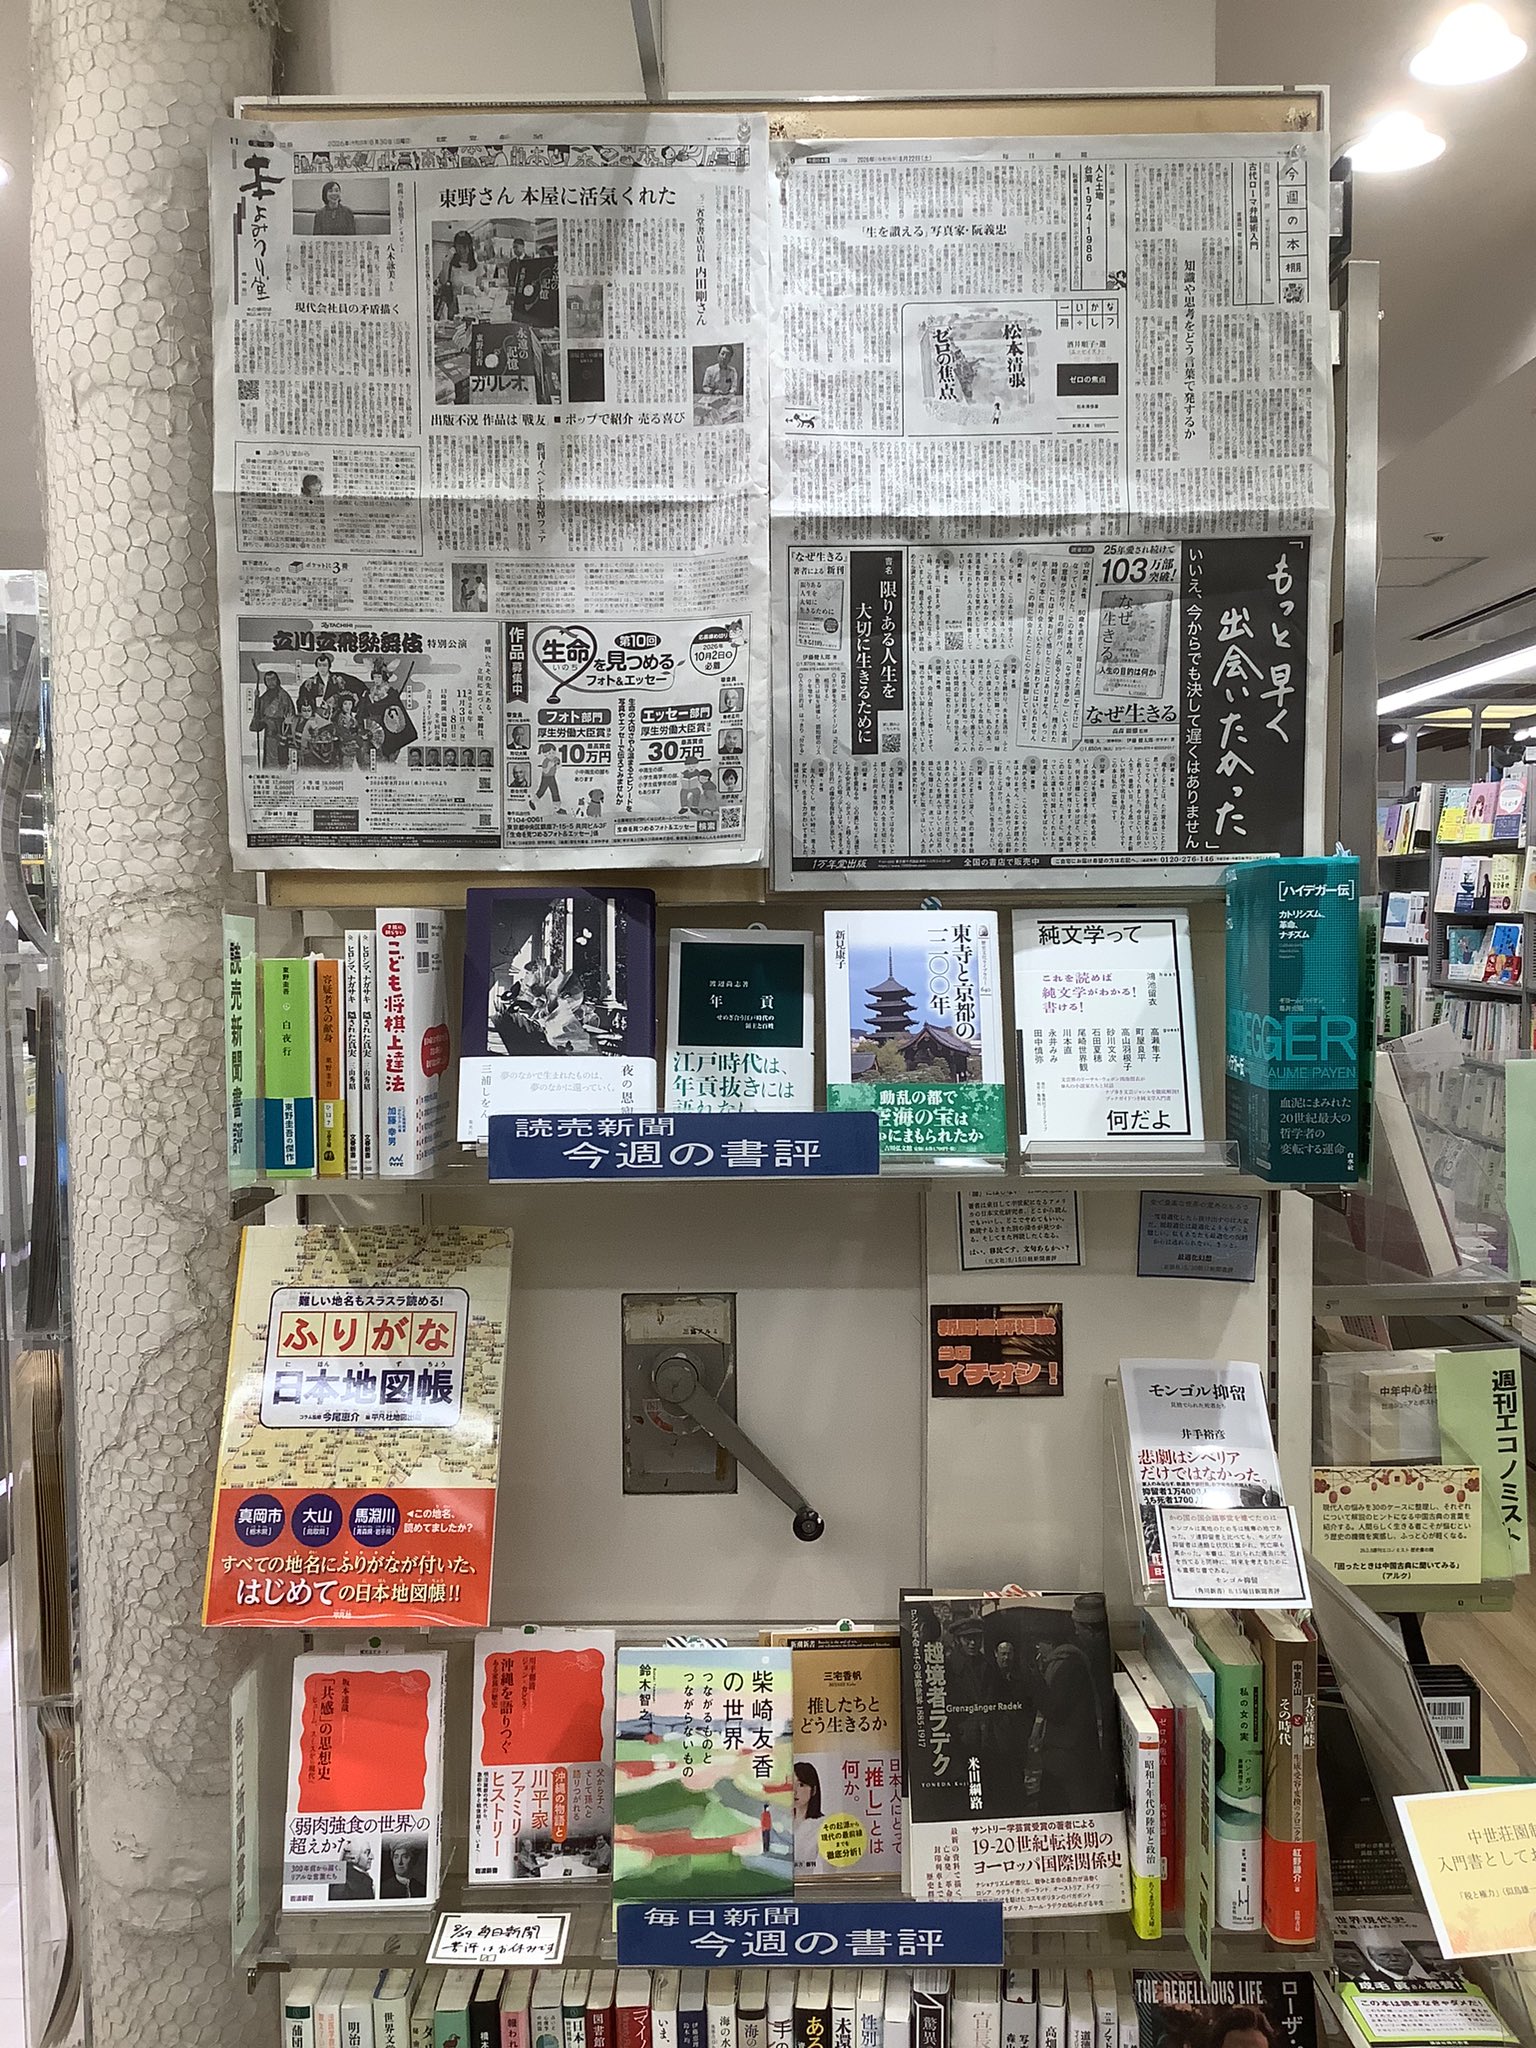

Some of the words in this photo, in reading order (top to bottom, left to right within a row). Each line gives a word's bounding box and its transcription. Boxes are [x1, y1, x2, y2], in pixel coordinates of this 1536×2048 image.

[1095, 164, 1103, 200] 人と土地
[439, 187, 514, 208] 東野さん
[521, 186, 676, 206] 本屋に活気くれた
[1285, 167, 1302, 273] 今週の本棚
[295, 303, 399, 314] 現代会社員の矛盾描く
[1003, 324, 1026, 388] 松本清張
[1184, 259, 1196, 440] 知識や思考をどう言葉で発するか
[932, 326, 957, 400] ゼロの焦点
[1069, 376, 1106, 384] ゼロの焦点
[431, 414, 478, 426] 出版不況
[638, 413, 685, 424] 売る喜び
[1102, 558, 1147, 583] 103
[273, 631, 423, 653] 立川立飛歌舞伎
[427, 639, 467, 649] 特別公演
[618, 635, 657, 647] 第10回
[880, 579, 897, 699] 限りある人生を
[1101, 612, 1116, 661] 生きる
[509, 627, 525, 695] 作品募集中
[542, 640, 590, 664] 生命
[594, 651, 674, 671] を見つめる
[586, 675, 667, 686] フォト&エッセー
[855, 602, 873, 743] 大切に生きるために
[1099, 667, 1157, 676] 人生の目的は何か
[1185, 549, 1204, 849] いいえ、今からでも決して遅くはありません
[547, 711, 603, 723] フォト部門
[643, 707, 710, 721] エッセー部門
[1086, 703, 1177, 724] なぜ生きる
[538, 728, 606, 738] 厚生労働大臣賞
[641, 723, 706, 736] 厚生労働大臣賞
[558, 744, 611, 763] 10万円
[649, 741, 704, 761] 30万円
[963, 857, 1040, 866] 全国の書店で販売中
[1160, 855, 1214, 863] 0120-276-146
[1279, 910, 1325, 919] カトリシズム、
[1279, 920, 1298, 929] 革命、
[1038, 925, 1142, 945] 純文学って
[1279, 930, 1310, 939] ナチズム
[835, 930, 845, 969] 新見康子
[952, 923, 975, 1040] 東寺と京都の
[1042, 972, 1113, 985] これを読めば
[710, 994, 775, 1009] 年貢
[1042, 987, 1136, 999] 純文学がわかる!
[323, 975, 333, 1043] 容疑者Xの献身
[384, 941, 405, 1093] こども将棋上達法
[717, 1014, 775, 1022] せめぎ合う江戸時代の
[1043, 1001, 1084, 1013] 書ける!
[282, 1020, 291, 1056] 白夜行
[1034, 1029, 1044, 1064] 田中慎弥
[1048, 1029, 1058, 1063] 永井みみ
[1063, 1029, 1072, 1055] 川本直
[1077, 1029, 1088, 1072] 尾崎世界観
[1092, 1028, 1102, 1063] 石田夏穂
[1106, 1028, 1117, 1063] 砂川文次
[1121, 1028, 1133, 1072] 高山羽根子
[1136, 1028, 1146, 1062] 町屋良平
[500, 1070, 605, 1081] 夢のなかで生まれたものは、
[672, 1052, 788, 1075] 江戸時代は、
[1312, 1066, 1357, 1079] PAYEN
[481, 1064, 492, 1119] 三浦しをん
[672, 1075, 794, 1098] 年貢抜きには
[880, 1089, 957, 1105] 動乱の都で
[1280, 1097, 1351, 1109] 血泥にまみれた
[515, 1118, 675, 1138] 読売新聞
[1107, 1109, 1171, 1131] 何だよ
[1280, 1113, 1351, 1124] 20世紀最大の
[284, 1102, 295, 1161] 東野圭吾の傑作
[1280, 1128, 1325, 1140] 哲学者の
[562, 1139, 821, 1169] 今週の書評
[1280, 1143, 1346, 1155] 変転する運命
[299, 1295, 443, 1307] 難しい地名もスラスラ読める!
[282, 1317, 450, 1352] ふりがな
[273, 1368, 453, 1405] 日本地図帳
[938, 1362, 1058, 1387] イチオシ!
[1148, 1384, 1246, 1402] モンゴル抑留
[1138, 1449, 1240, 1465] 悲劇はシベリア
[1492, 1370, 1523, 1550] 週刊エコノミスト
[1140, 1466, 1268, 1484] だけではなかった。
[238, 1508, 283, 1524] 真岡市
[302, 1508, 332, 1524] 大山
[403, 1522, 473, 1534] 読めてましたか?
[222, 1555, 477, 1575] すべての地名にふりがなが付いた、
[237, 1579, 461, 1606] はじめての日本地図帳!!
[823, 1671, 862, 1681] 三宅香帆
[639, 1664, 651, 1721] 鈴木智之
[500, 1658, 515, 1754] 沖縄を語りつぐ
[723, 1672, 745, 1750] の世界
[808, 1696, 880, 1715] 推したちと
[924, 1642, 950, 1776] 越境者ラデク
[946, 1704, 996, 1713] Grenzgänger
[998, 1702, 1022, 1710] Radek
[1240, 1687, 1249, 1742] 私の女の実
[318, 1679, 336, 1781] 「共感」の思想史
[683, 1673, 695, 1778] つながらないもの
[702, 1673, 713, 1765] つながるものと
[752, 1670, 774, 1779] 柴崎友香
[801, 1716, 887, 1734] どう生きるか
[1278, 1698, 1292, 1746] その時代
[842, 1760, 860, 1802] 何か。
[968, 1757, 984, 1810] 米田綱路
[531, 1770, 549, 1829] 川平家
[555, 1772, 566, 1838] 沖縄の物語と
[573, 1770, 581, 1821] 語りつがれる
[865, 1759, 884, 1855] 「推し」とは
[491, 1772, 505, 1857] ヒストリー
[1144, 1760, 1156, 1864] 昭和十年代の陸軍と政治
[821, 1831, 863, 1841] 現代の最前線
[823, 1822, 859, 1831] その起源から
[971, 1820, 1095, 1833] サントリー学芸賞受賞の著者による
[289, 1837, 352, 1855] 超えかた
[973, 1832, 1113, 1855] 19-20世紀転換期の
[973, 1851, 1122, 1875] ヨーロッパ国際関係史
[643, 1907, 801, 1928] 毎日新聞
[690, 1930, 945, 1957] 今週の書評
[1135, 1980, 1160, 2004] THE
[1163, 1980, 1235, 2005] REBELLIOUS
[1238, 1980, 1264, 2005] LIFE
[593, 2014, 605, 2047] 図書館
[720, 2015, 730, 2047] 海の水
[861, 2013, 878, 2047] 性別
[922, 2016, 938, 2046] 驚異
